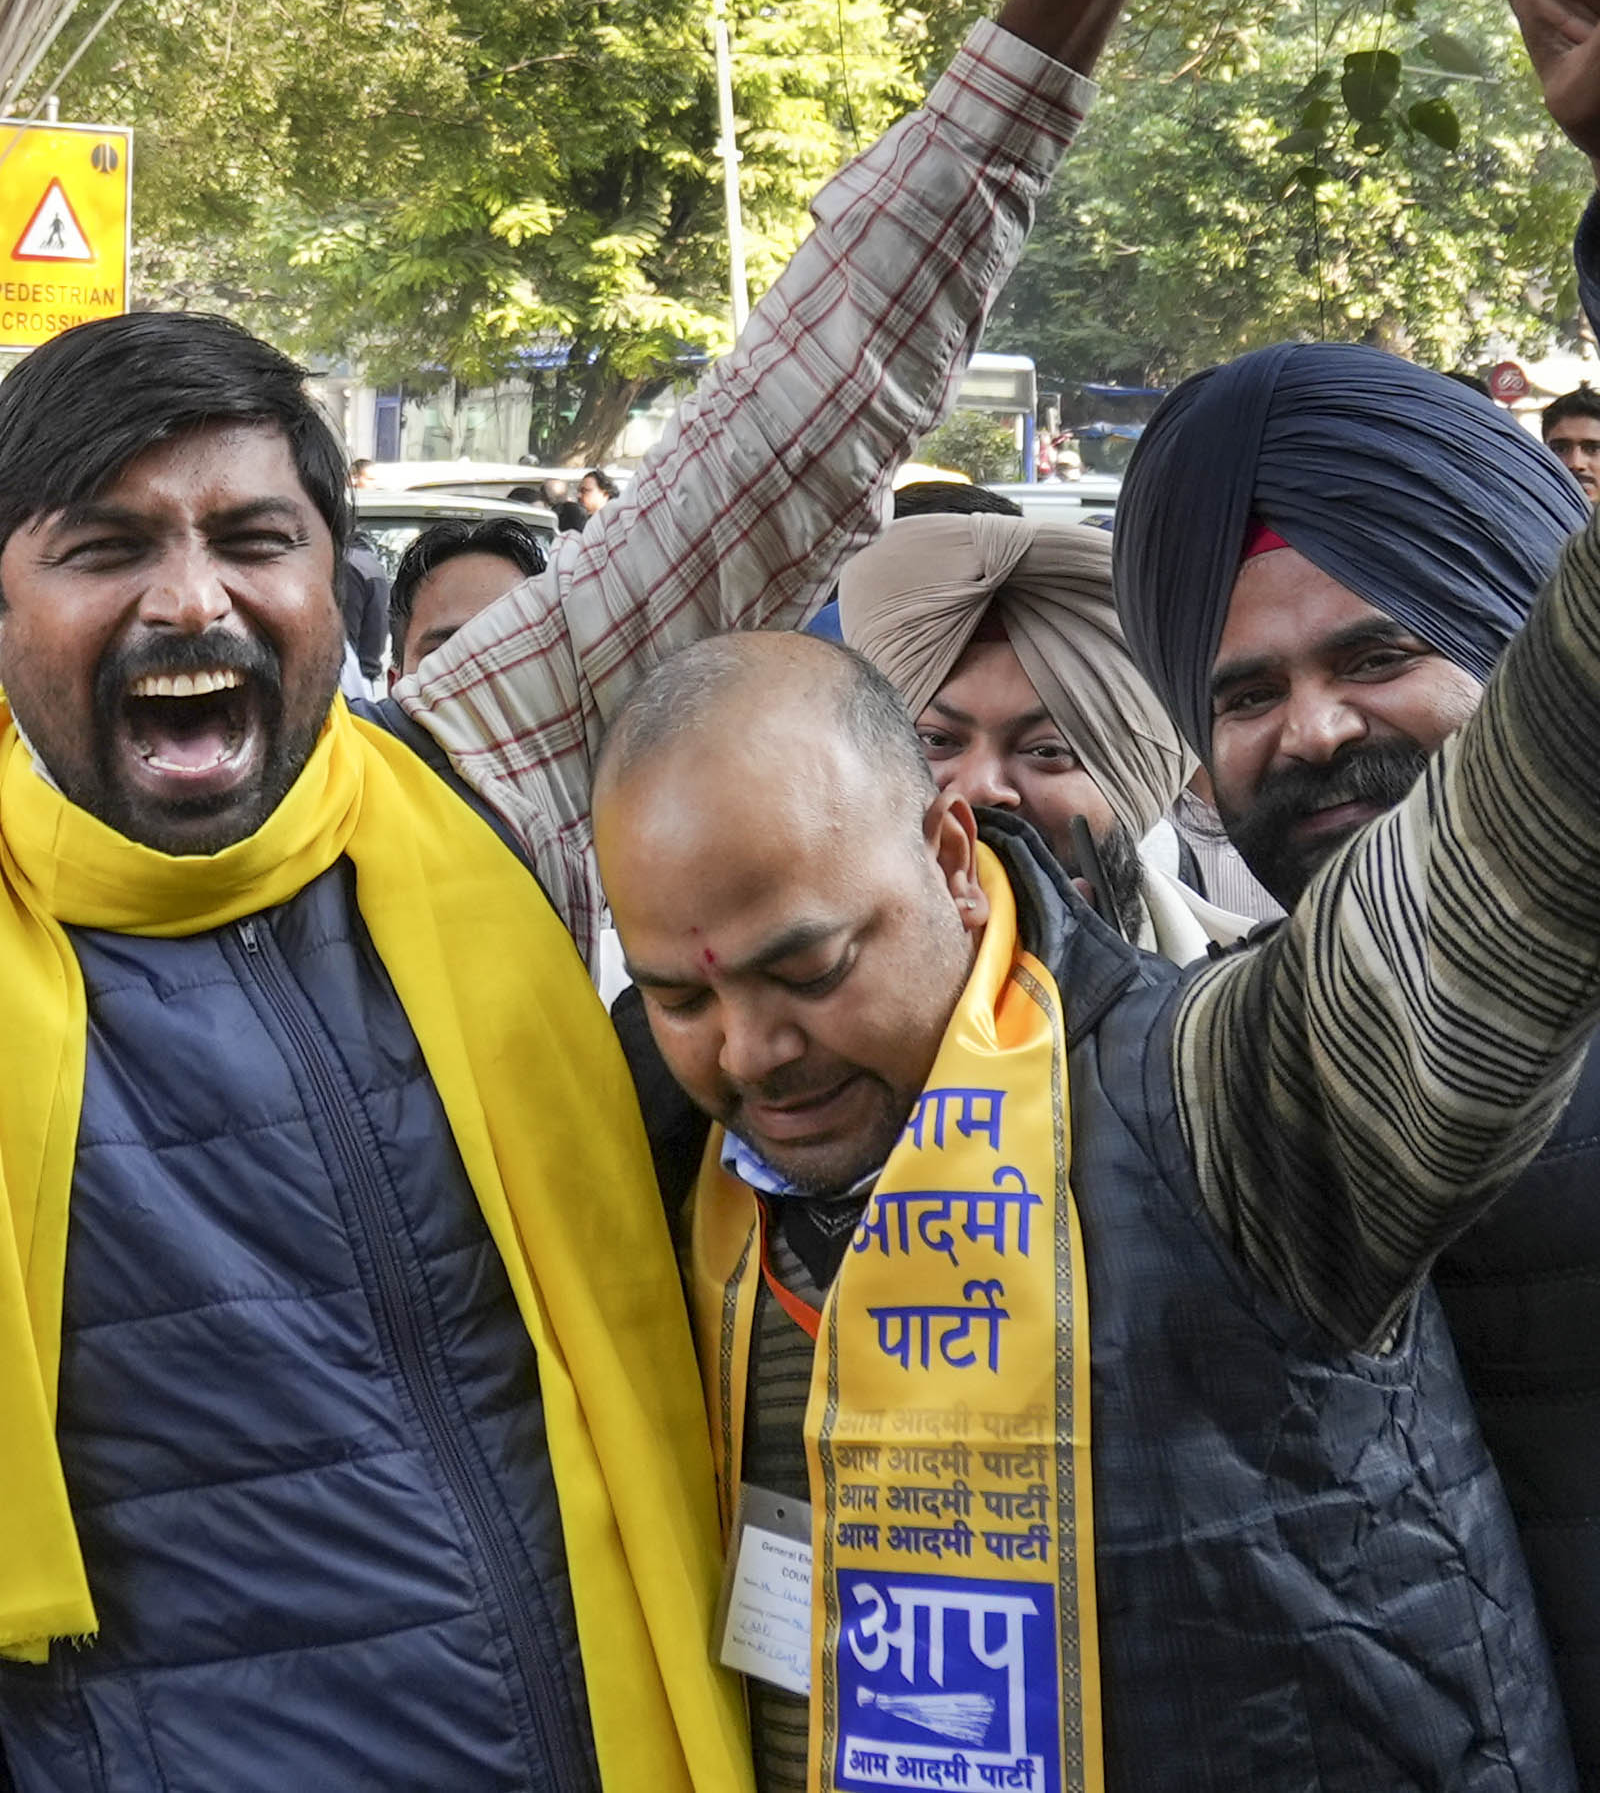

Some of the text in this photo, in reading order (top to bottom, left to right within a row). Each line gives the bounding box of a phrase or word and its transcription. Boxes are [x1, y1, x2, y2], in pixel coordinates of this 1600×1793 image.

[2, 311, 102, 331] CROSSI
[866, 1278, 1011, 1374] पार्टी
[835, 1441, 1050, 1481] आम आदमी पार्टी
[838, 1479, 1052, 1523] आम आदमी पार्टी
[836, 1519, 1053, 1564] आम आदमी पार्टी
[848, 1582, 1040, 1757] आप
[849, 1749, 1036, 1791] आम आदमी पार्टी
